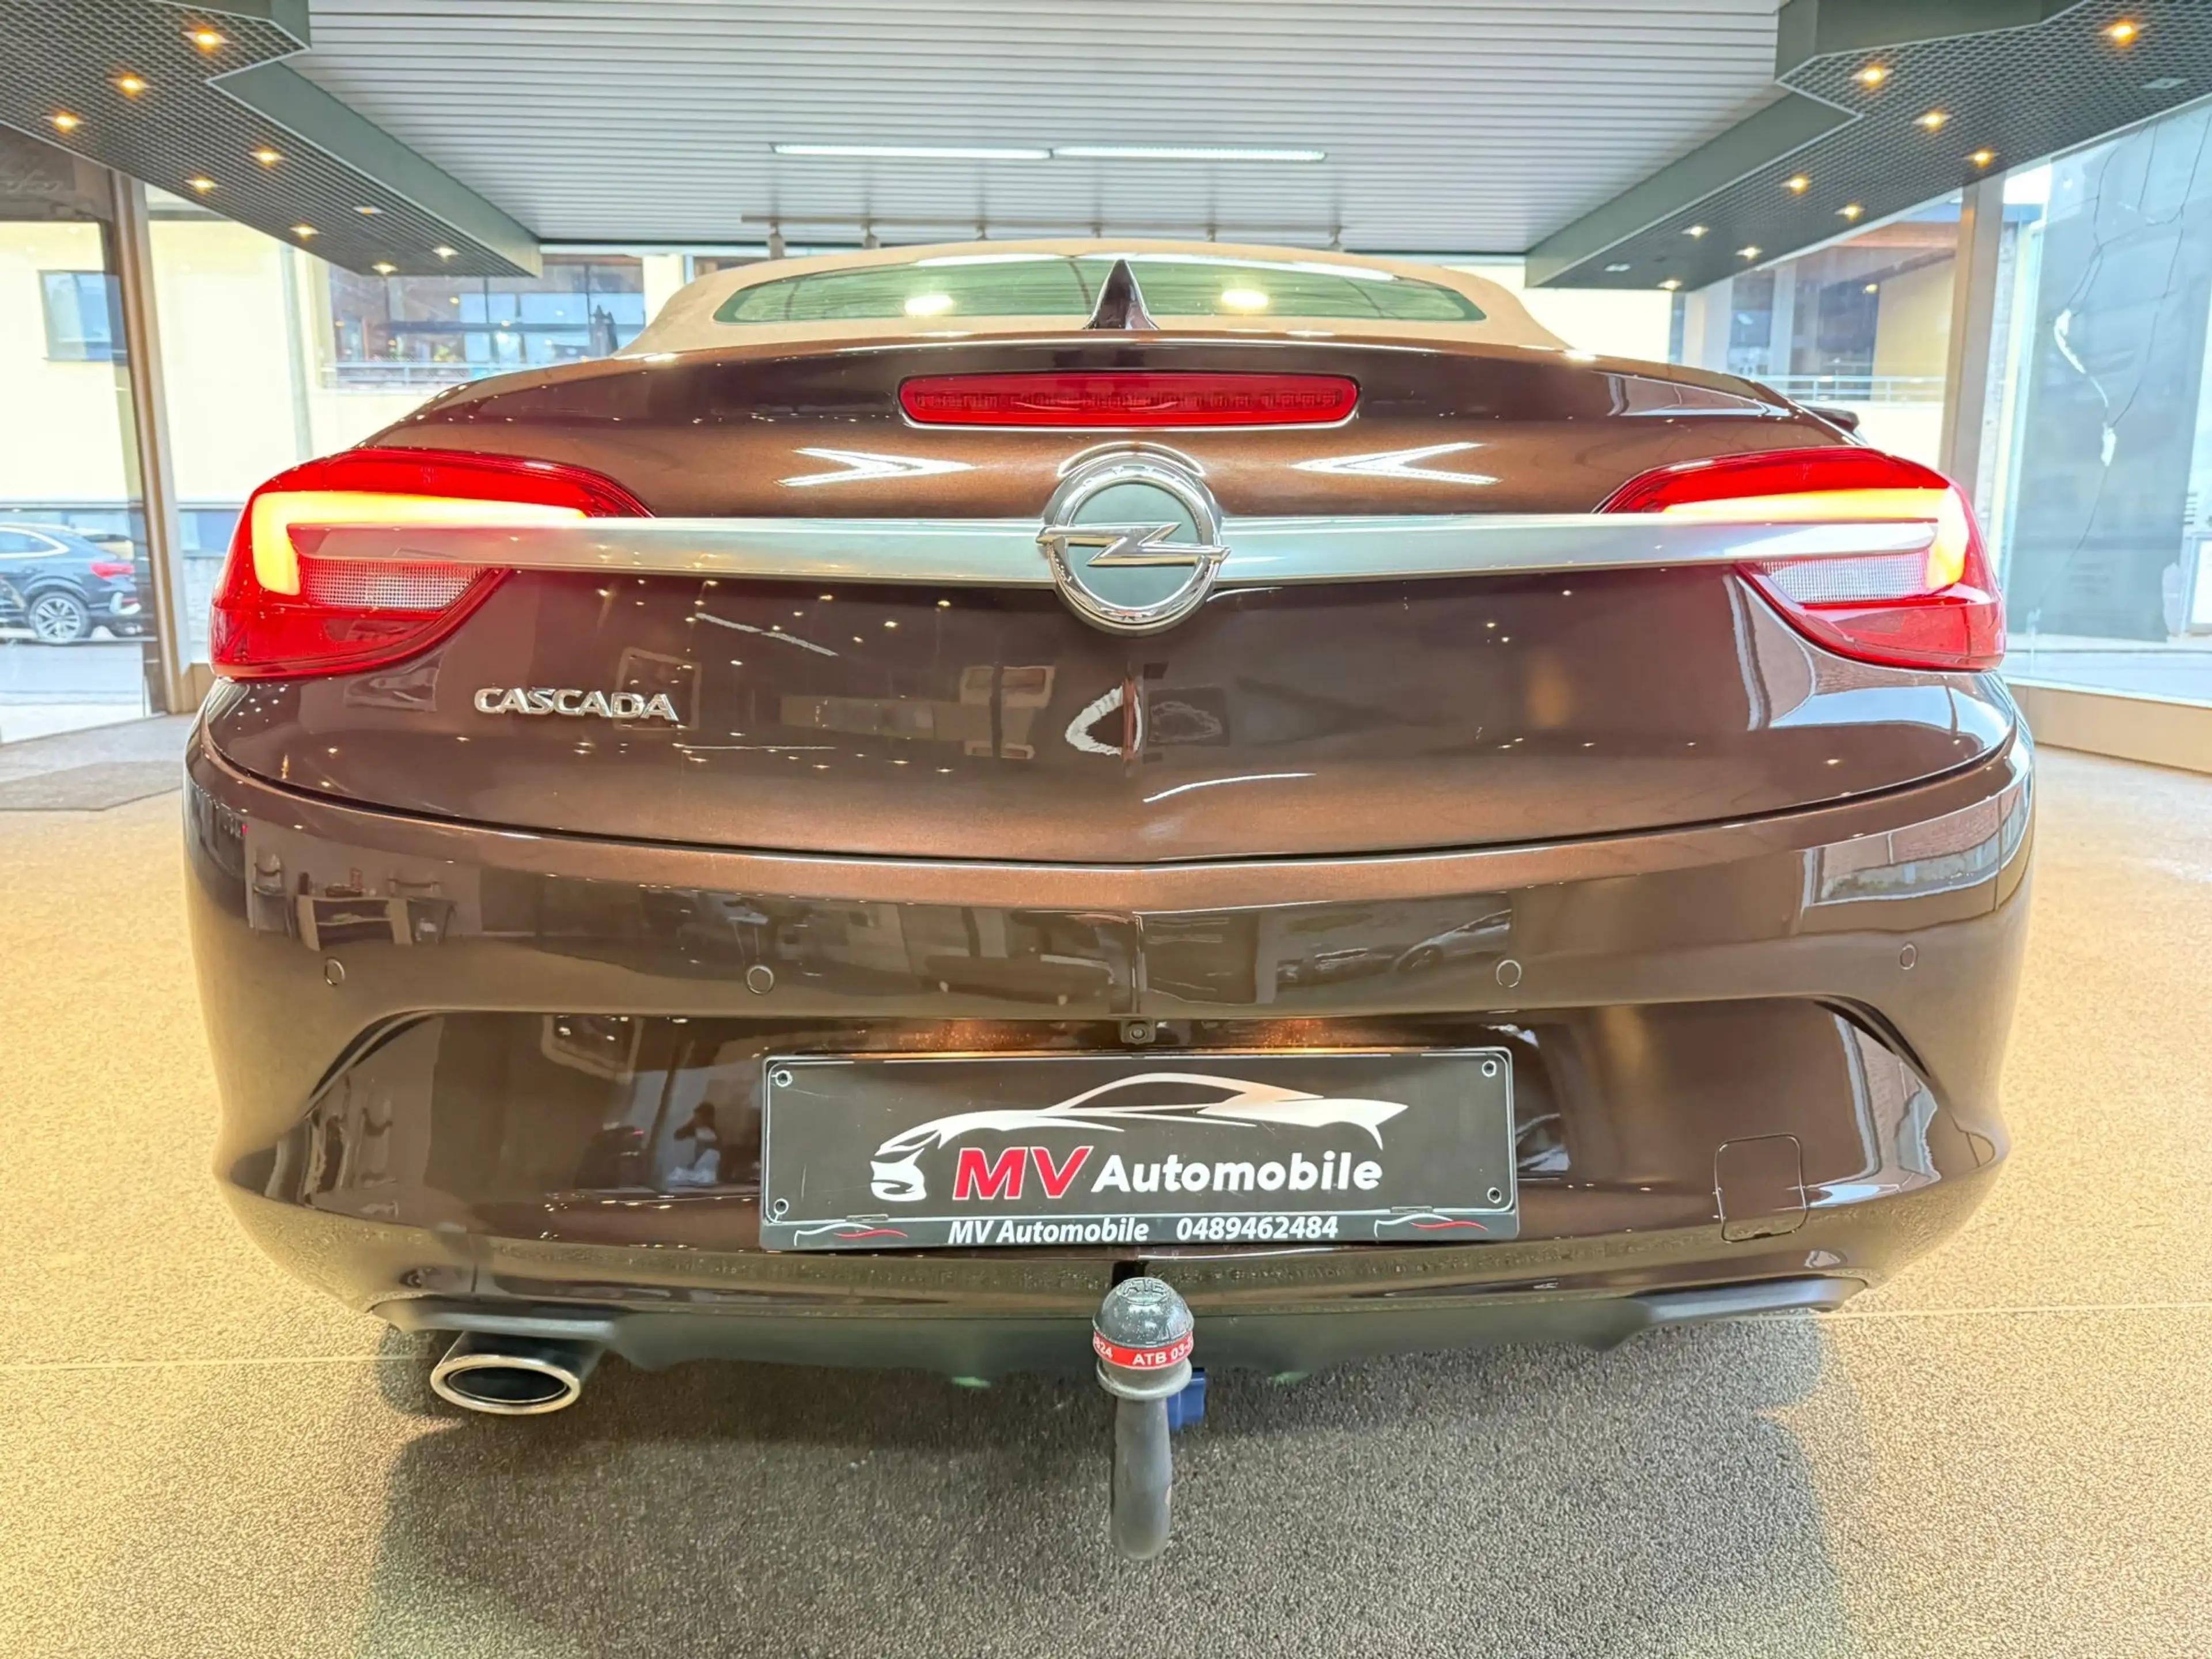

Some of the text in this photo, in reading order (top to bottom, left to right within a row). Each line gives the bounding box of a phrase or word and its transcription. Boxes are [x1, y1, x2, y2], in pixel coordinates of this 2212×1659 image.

[474, 687, 679, 721] CASCADA
[952, 1145, 1383, 1200] MV Automobile
[948, 1215, 1338, 1244] MV Automobile 0489462484
[1132, 1352, 1167, 1366] ATB
